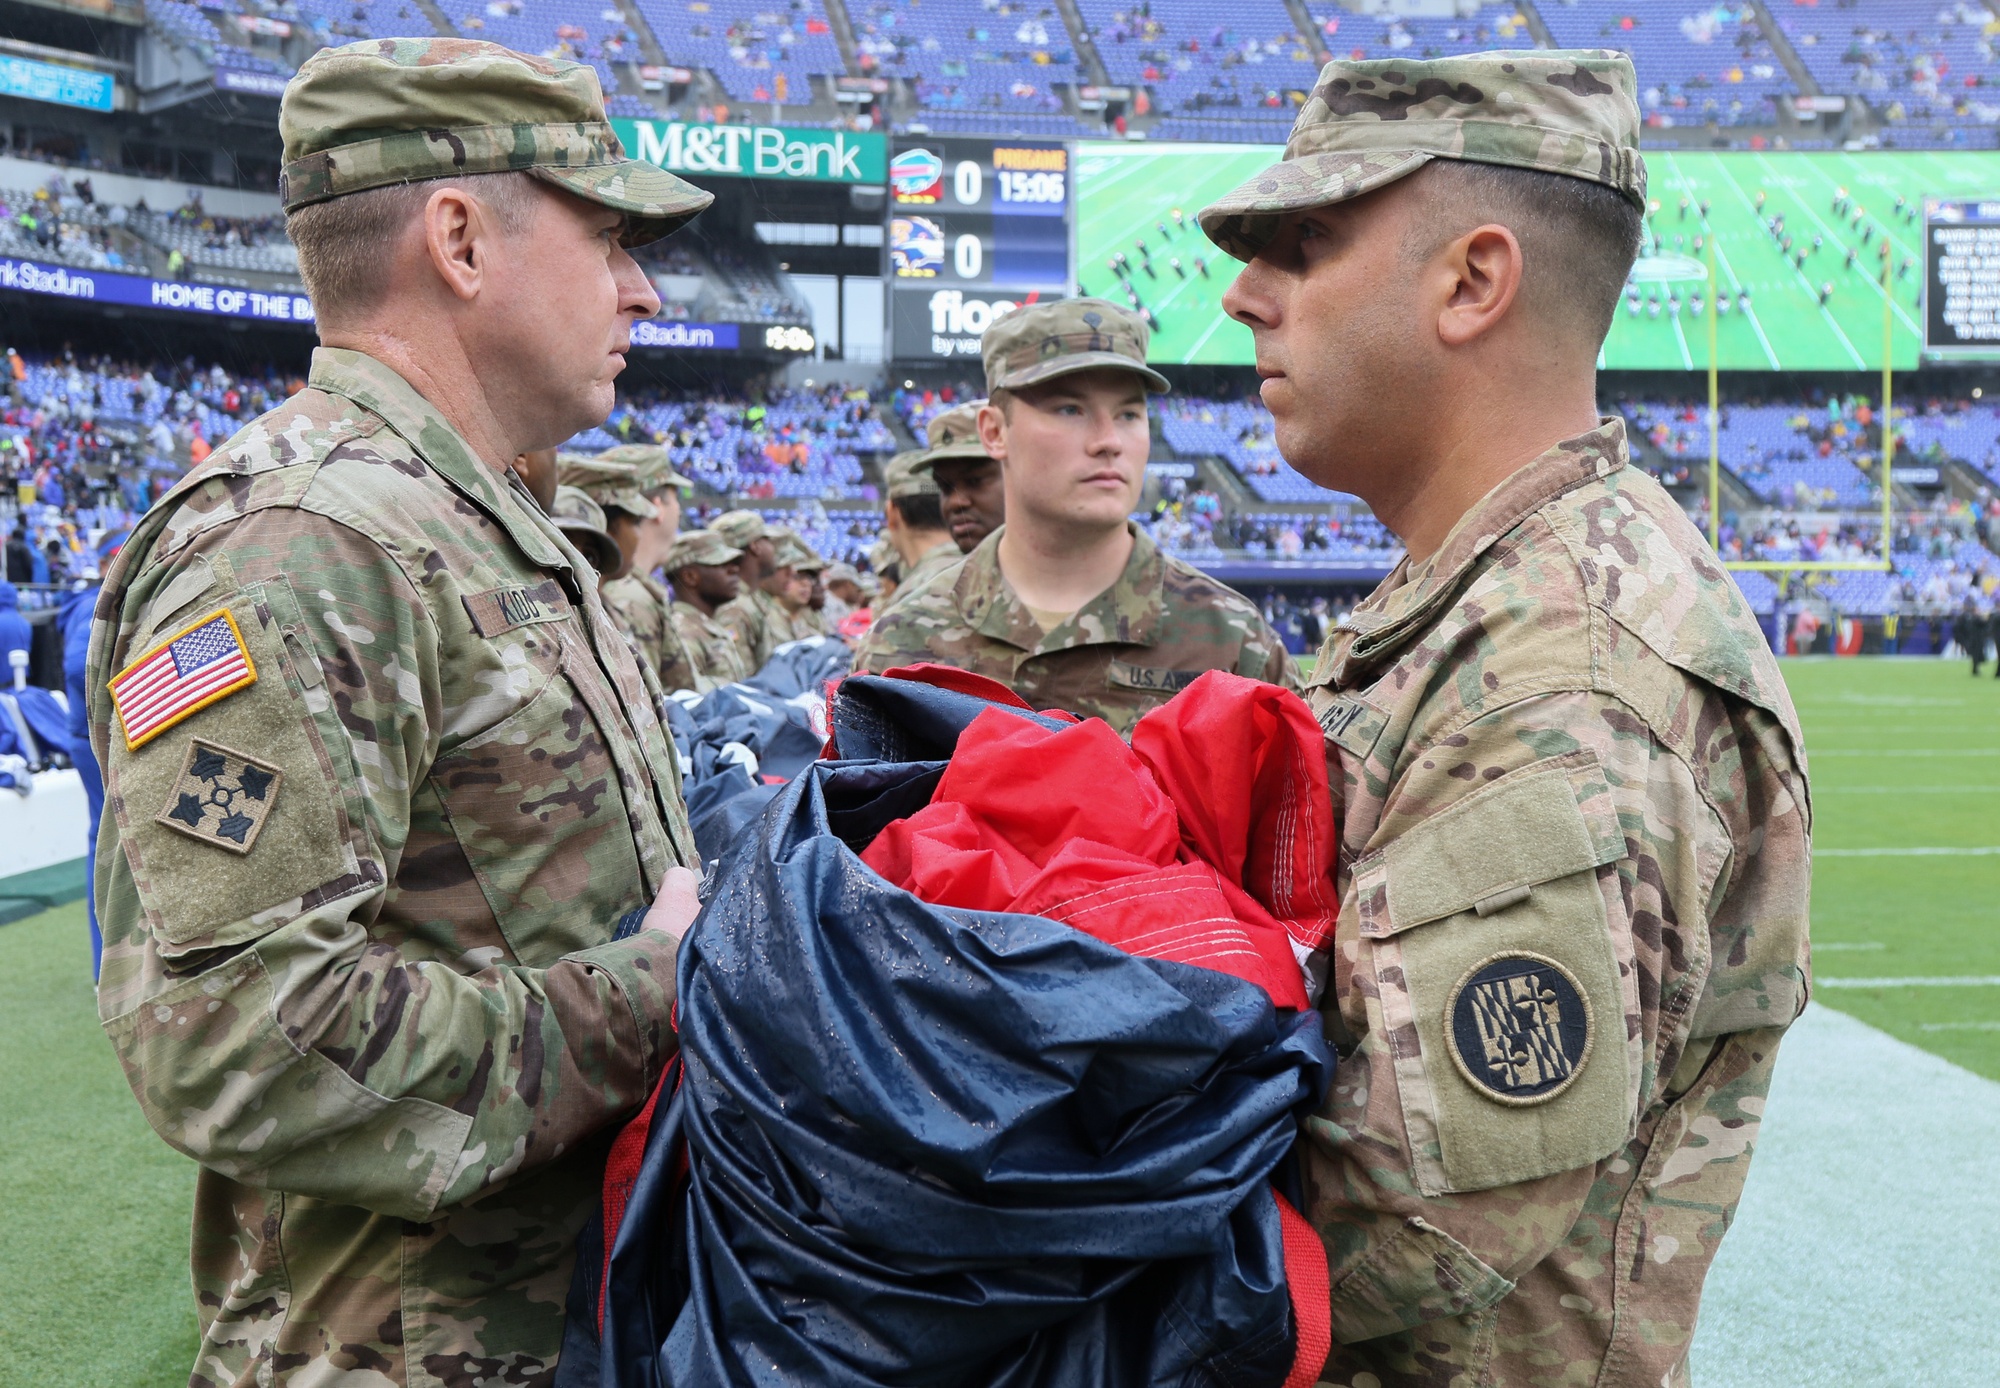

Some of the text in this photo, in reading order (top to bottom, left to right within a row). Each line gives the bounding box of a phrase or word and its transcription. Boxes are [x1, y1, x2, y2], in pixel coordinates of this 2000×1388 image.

[754, 127, 862, 179] Bank
[954, 160, 982, 205] 0
[998, 171, 1065, 203] 15:06
[954, 234, 982, 279] 0
[20, 262, 94, 298] Stadium
[152, 281, 215, 310] HOME
[216, 289, 248, 313] OF
[249, 293, 290, 318] THE
[495, 589, 540, 626] KIDD
[1130, 666, 1158, 688] U.S.
